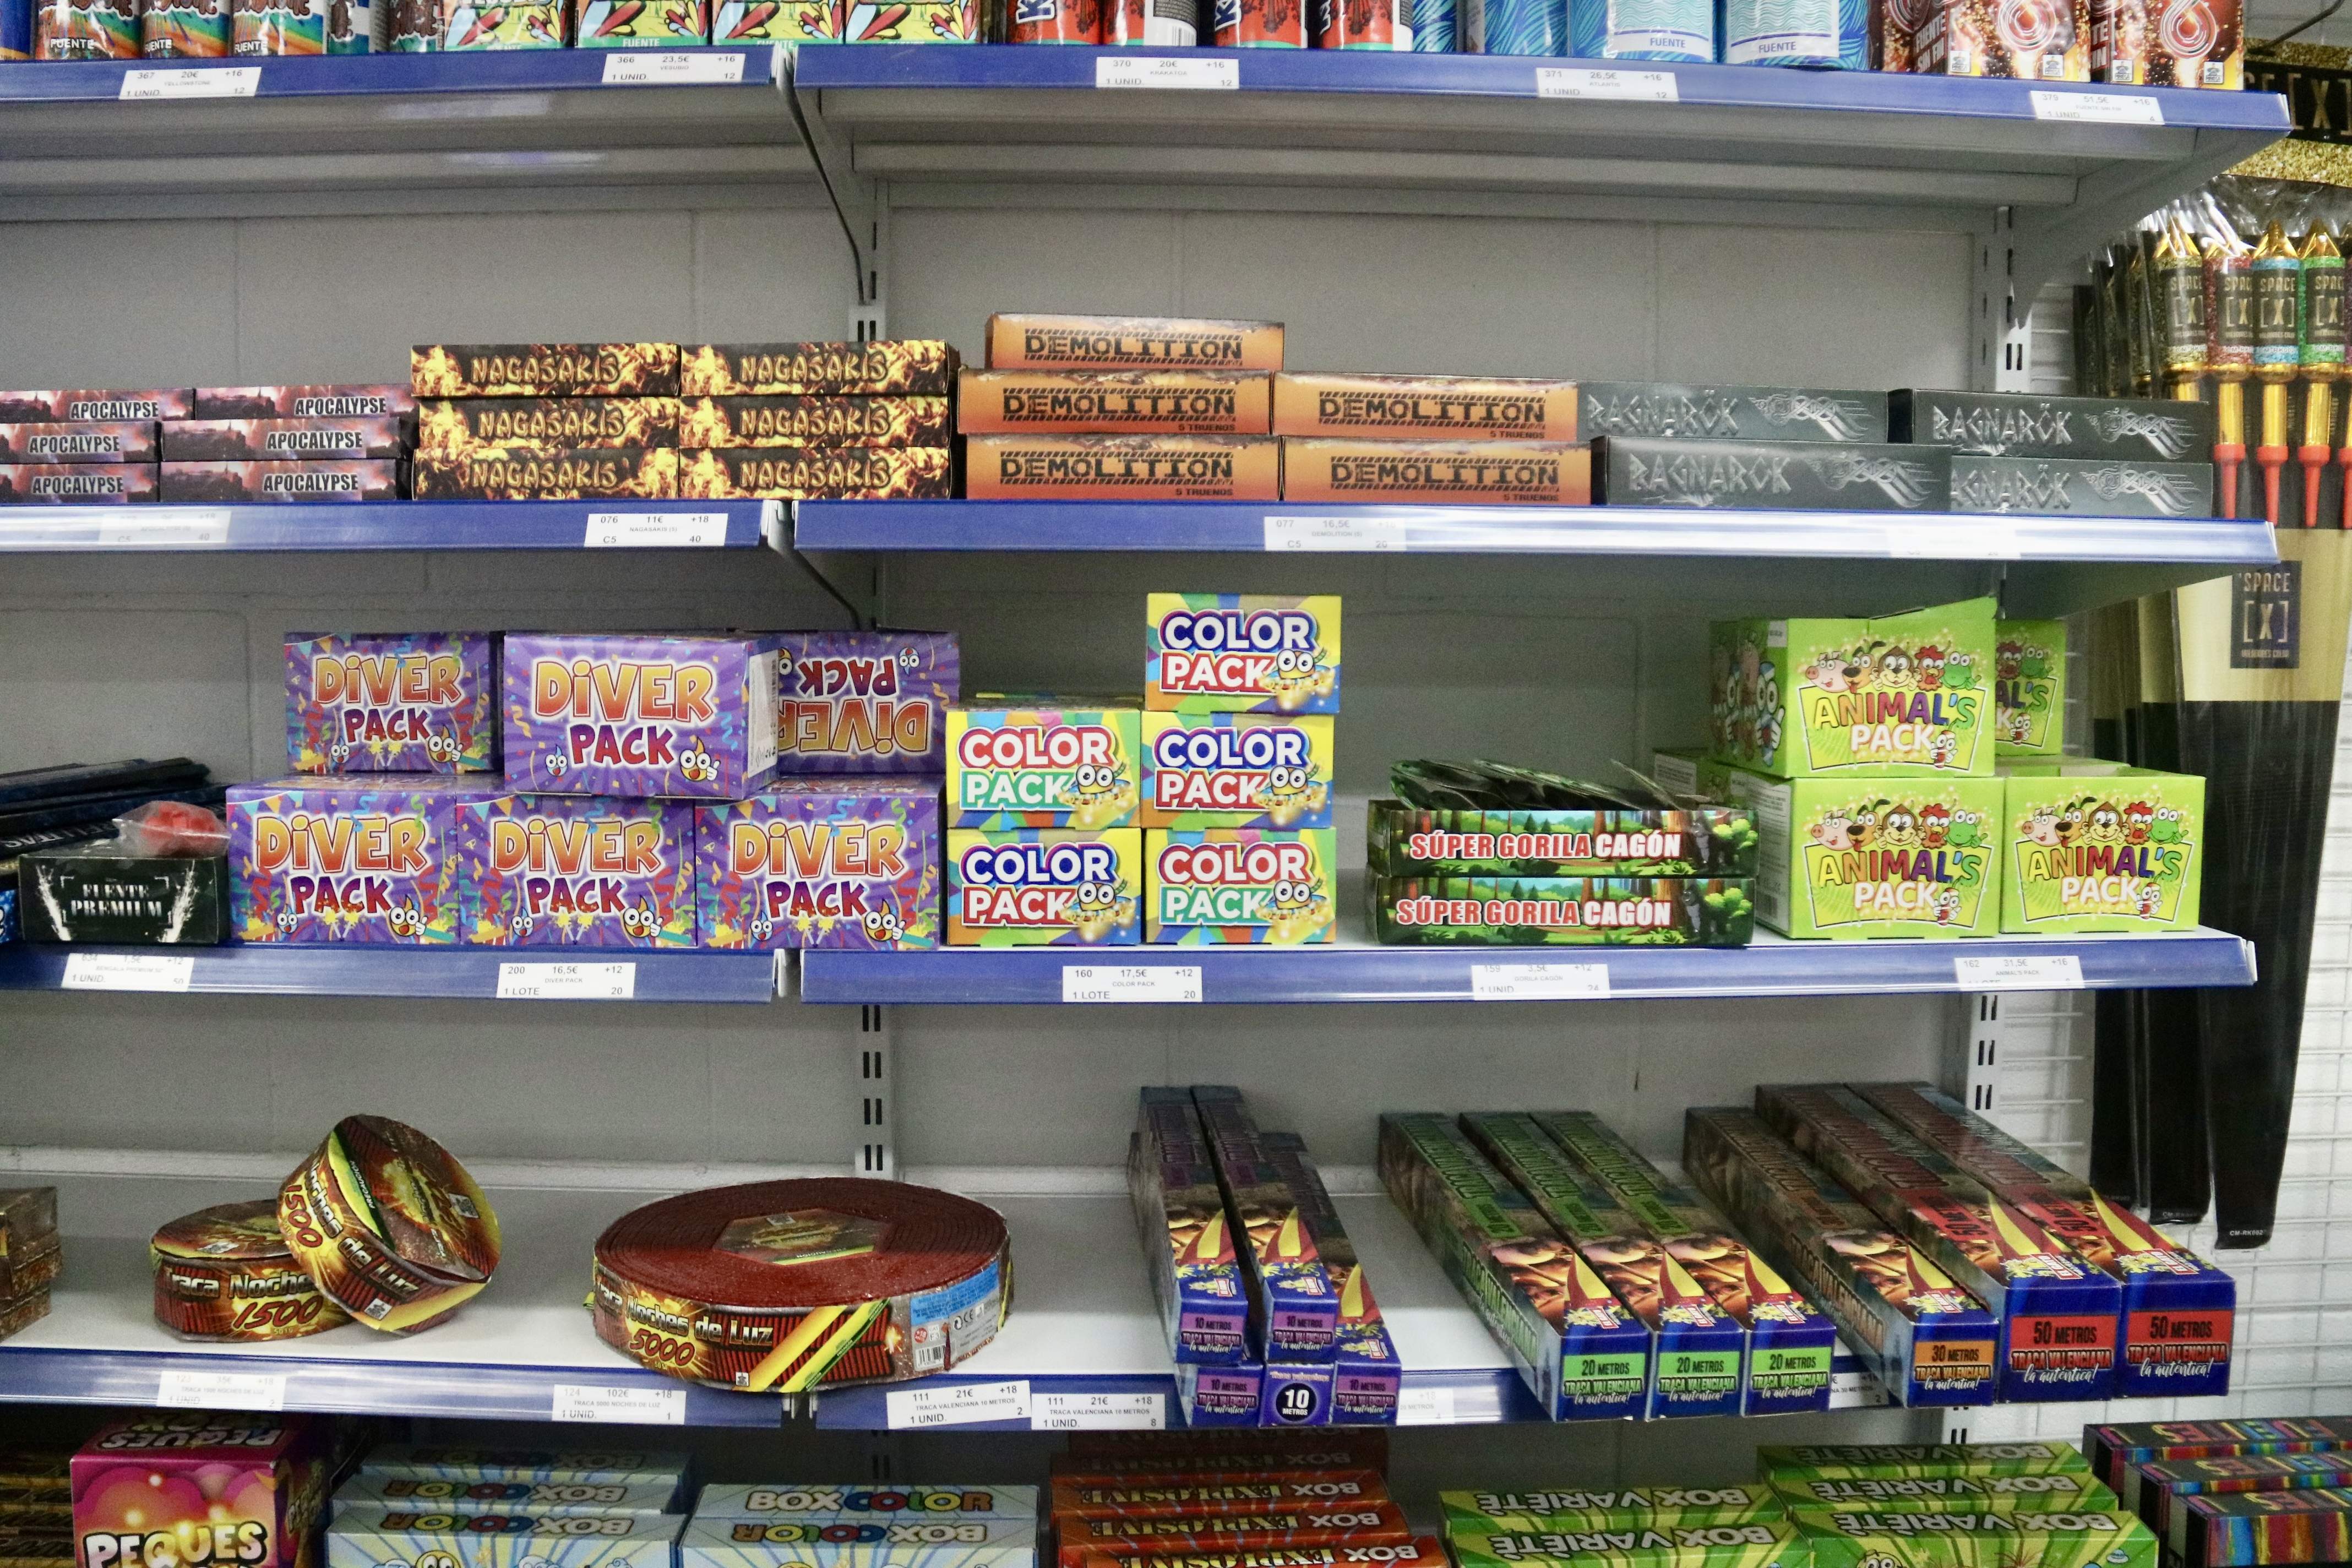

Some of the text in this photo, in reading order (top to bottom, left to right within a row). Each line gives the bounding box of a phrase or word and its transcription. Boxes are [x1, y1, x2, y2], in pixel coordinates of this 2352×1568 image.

[622, 37, 660, 47] FUENTE
[1649, 37, 1686, 48] FUENTE
[1758, 41, 1797, 54] FUENTE
[662, 56, 689, 64] 23,5€
[1206, 61, 1225, 69] +16
[1589, 72, 1617, 80] 26,5€
[1025, 335, 1243, 359] DEMOLITION
[472, 353, 619, 384] NAGASAKIS
[739, 352, 889, 383] NAGASAKIS
[70, 401, 159, 420] APOCALYPSE
[294, 396, 387, 417] APOCALYPSE
[1003, 394, 1236, 415] DEMOLITION
[1319, 398, 1545, 422] DEMOLITION
[478, 408, 626, 439] NAGASAKIS
[739, 407, 890, 436] NAGASAKIS
[29, 434, 121, 454] APOCALYPSE
[266, 431, 363, 450] APOCALYPSE
[1498, 431, 1545, 439] TRUENOS
[471, 458, 617, 489] NAGASAKIS
[739, 458, 891, 489] NAGASAKIS
[1000, 458, 1233, 478] DEMOLITION
[1331, 464, 1559, 485] DEMOLITION
[31, 476, 124, 495] APOCALYPSE
[262, 472, 359, 492] APOCALYPSE
[646, 515, 663, 524] 11€
[1276, 519, 1294, 528] 077
[2244, 572, 2291, 593] SPACE
[1164, 614, 1311, 651] COLOR
[797, 658, 897, 697] PACK
[1166, 654, 1274, 689] PACK
[1814, 692, 1977, 729] ANIMAL'S
[344, 707, 432, 744] PACK
[569, 723, 675, 767] PACK
[1850, 723, 1935, 753] PACK
[963, 732, 1111, 767] COLOR
[1157, 733, 1304, 769] COLOR
[965, 774, 1071, 807] PACK
[1160, 773, 1266, 806] PACK
[1410, 829, 1681, 859] SÚPER GORILA CAGÓN
[965, 849, 1111, 884] COLOR
[1162, 848, 1308, 883] COLOR
[1818, 849, 1983, 888] ANIMAL'S
[2028, 846, 2183, 882] ANIMAL'S
[290, 875, 391, 916] PACK
[525, 876, 627, 917] PACK
[765, 880, 869, 921] PACK
[1854, 882, 1939, 912] PACK
[2061, 876, 2141, 906] PACK
[967, 890, 1071, 922] PACK
[1165, 888, 1270, 921] PACK
[1397, 896, 1672, 927] SÚPER GORILA CAGÓN
[508, 965, 623, 976] 200 16,5€ +12
[1484, 964, 1548, 973] 159 3,5€
[1964, 958, 2028, 968] 162 31,5€
[1075, 969, 1193, 979] 160 17,5€ +12
[512, 987, 623, 996] LOTE 20
[1073, 990, 1196, 1000] 1 LOTE 20
[228, 1270, 318, 1300] Noche
[233, 1298, 324, 1330] 1500
[627, 1294, 774, 1345] Noches de Luz
[2033, 1321, 2098, 1344] 50 METROS
[2149, 1316, 2213, 1338] 50 METROS
[629, 1327, 696, 1366] 5000
[1931, 1345, 1946, 1362] 30
[1581, 1359, 1630, 1376] 20 METROS
[1677, 1357, 1725, 1373] 20 METROS
[1769, 1354, 1817, 1370] 20 METROS
[607, 1389, 629, 1398] 102€
[913, 1385, 1017, 1402] 111 21€ +18
[1047, 1396, 1153, 1406] 111 21€ +18
[1284, 1388, 1310, 1408] 10
[1016, 1407, 1023, 1415] 2
[1052, 1418, 1157, 1428] UNID. 8
[1291, 1482, 1362, 1496] BOX
[1980, 1473, 2082, 1494] BOX
[745, 1490, 993, 1512] BOX COLOR
[1652, 1487, 1753, 1507] BOX
[533, 1516, 635, 1536] BOX
[1090, 1511, 1382, 1537] BOX EXPLOSIVE
[2011, 1511, 2121, 1532] BOX
[731, 1523, 987, 1543] BOX COLOR
[1673, 1523, 1778, 1547] BOX
[83, 1521, 268, 1568] PEQUES
[1343, 1545, 1419, 1562] BOX
